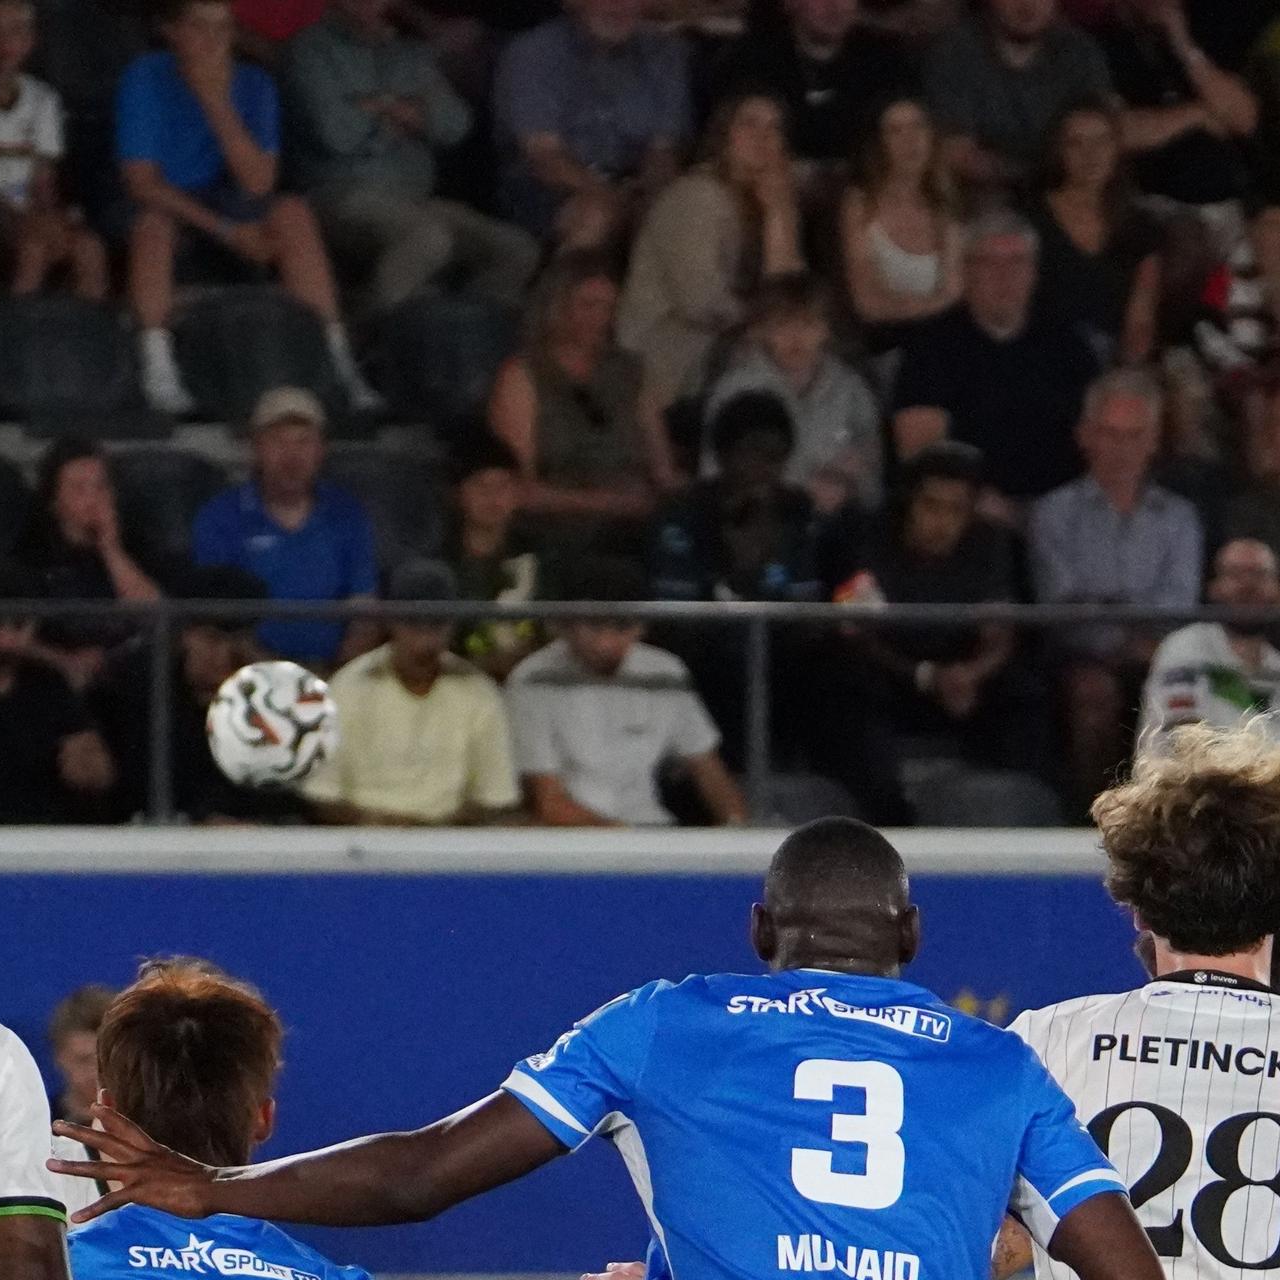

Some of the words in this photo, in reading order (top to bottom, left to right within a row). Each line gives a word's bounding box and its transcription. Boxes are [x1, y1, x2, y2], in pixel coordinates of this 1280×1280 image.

[727, 993, 814, 1015] STAR
[920, 1015, 945, 1035] TV
[791, 1059, 905, 1209] 3
[129, 1246, 206, 1274] STAR
